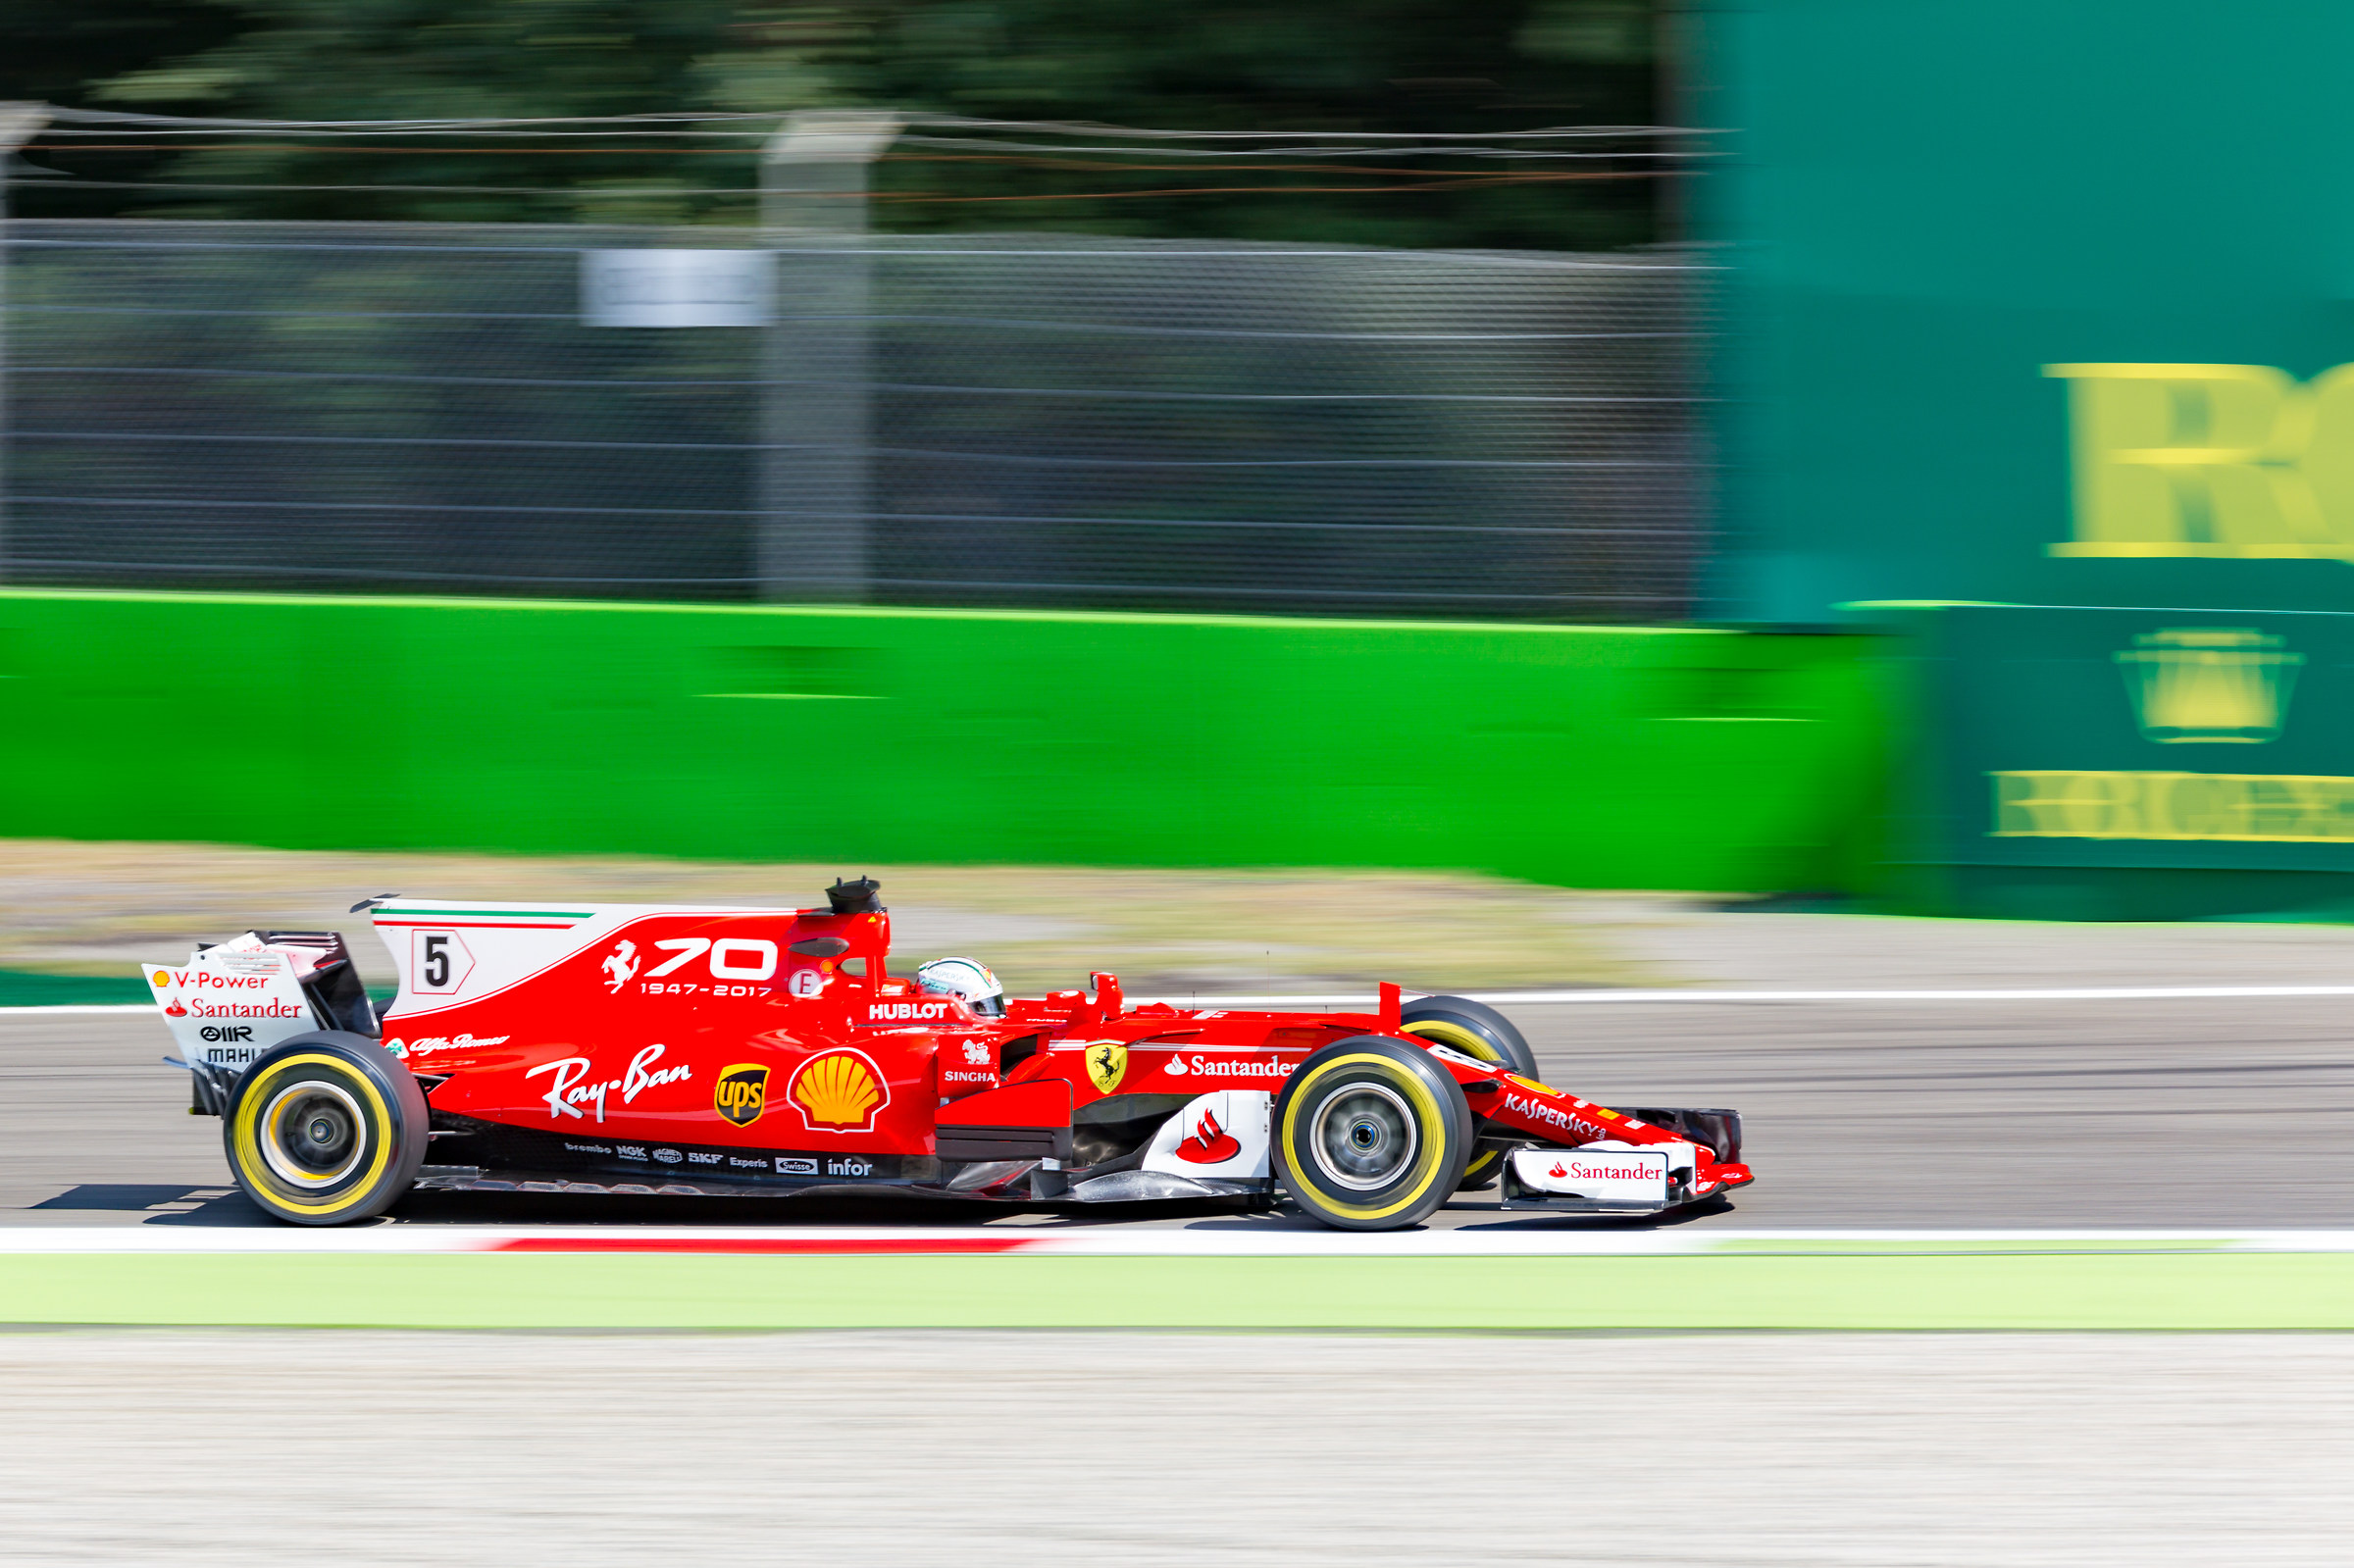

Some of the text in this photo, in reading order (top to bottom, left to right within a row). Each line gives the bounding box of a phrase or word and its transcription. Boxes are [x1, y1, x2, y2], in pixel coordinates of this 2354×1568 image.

[426, 936, 448, 986] 5
[643, 937, 779, 981] 70
[174, 972, 269, 989] V-Power
[640, 983, 773, 997] 1947-2017
[190, 997, 302, 1019] Santander
[869, 1003, 948, 1020] HUBLOT
[409, 1033, 511, 1056] Alfa Romeo
[208, 1048, 270, 1062] MAHL
[945, 1071, 997, 1083] SINGHA
[718, 1082, 762, 1118] ups
[1505, 1093, 1600, 1137] KASPERSKY
[564, 1142, 612, 1154] brembo
[615, 1145, 647, 1157] NGK
[688, 1152, 724, 1164] SKF
[729, 1156, 768, 1168] Experis
[782, 1162, 811, 1171] Swisse
[827, 1158, 873, 1176] infor
[1570, 1162, 1663, 1180] Santander
